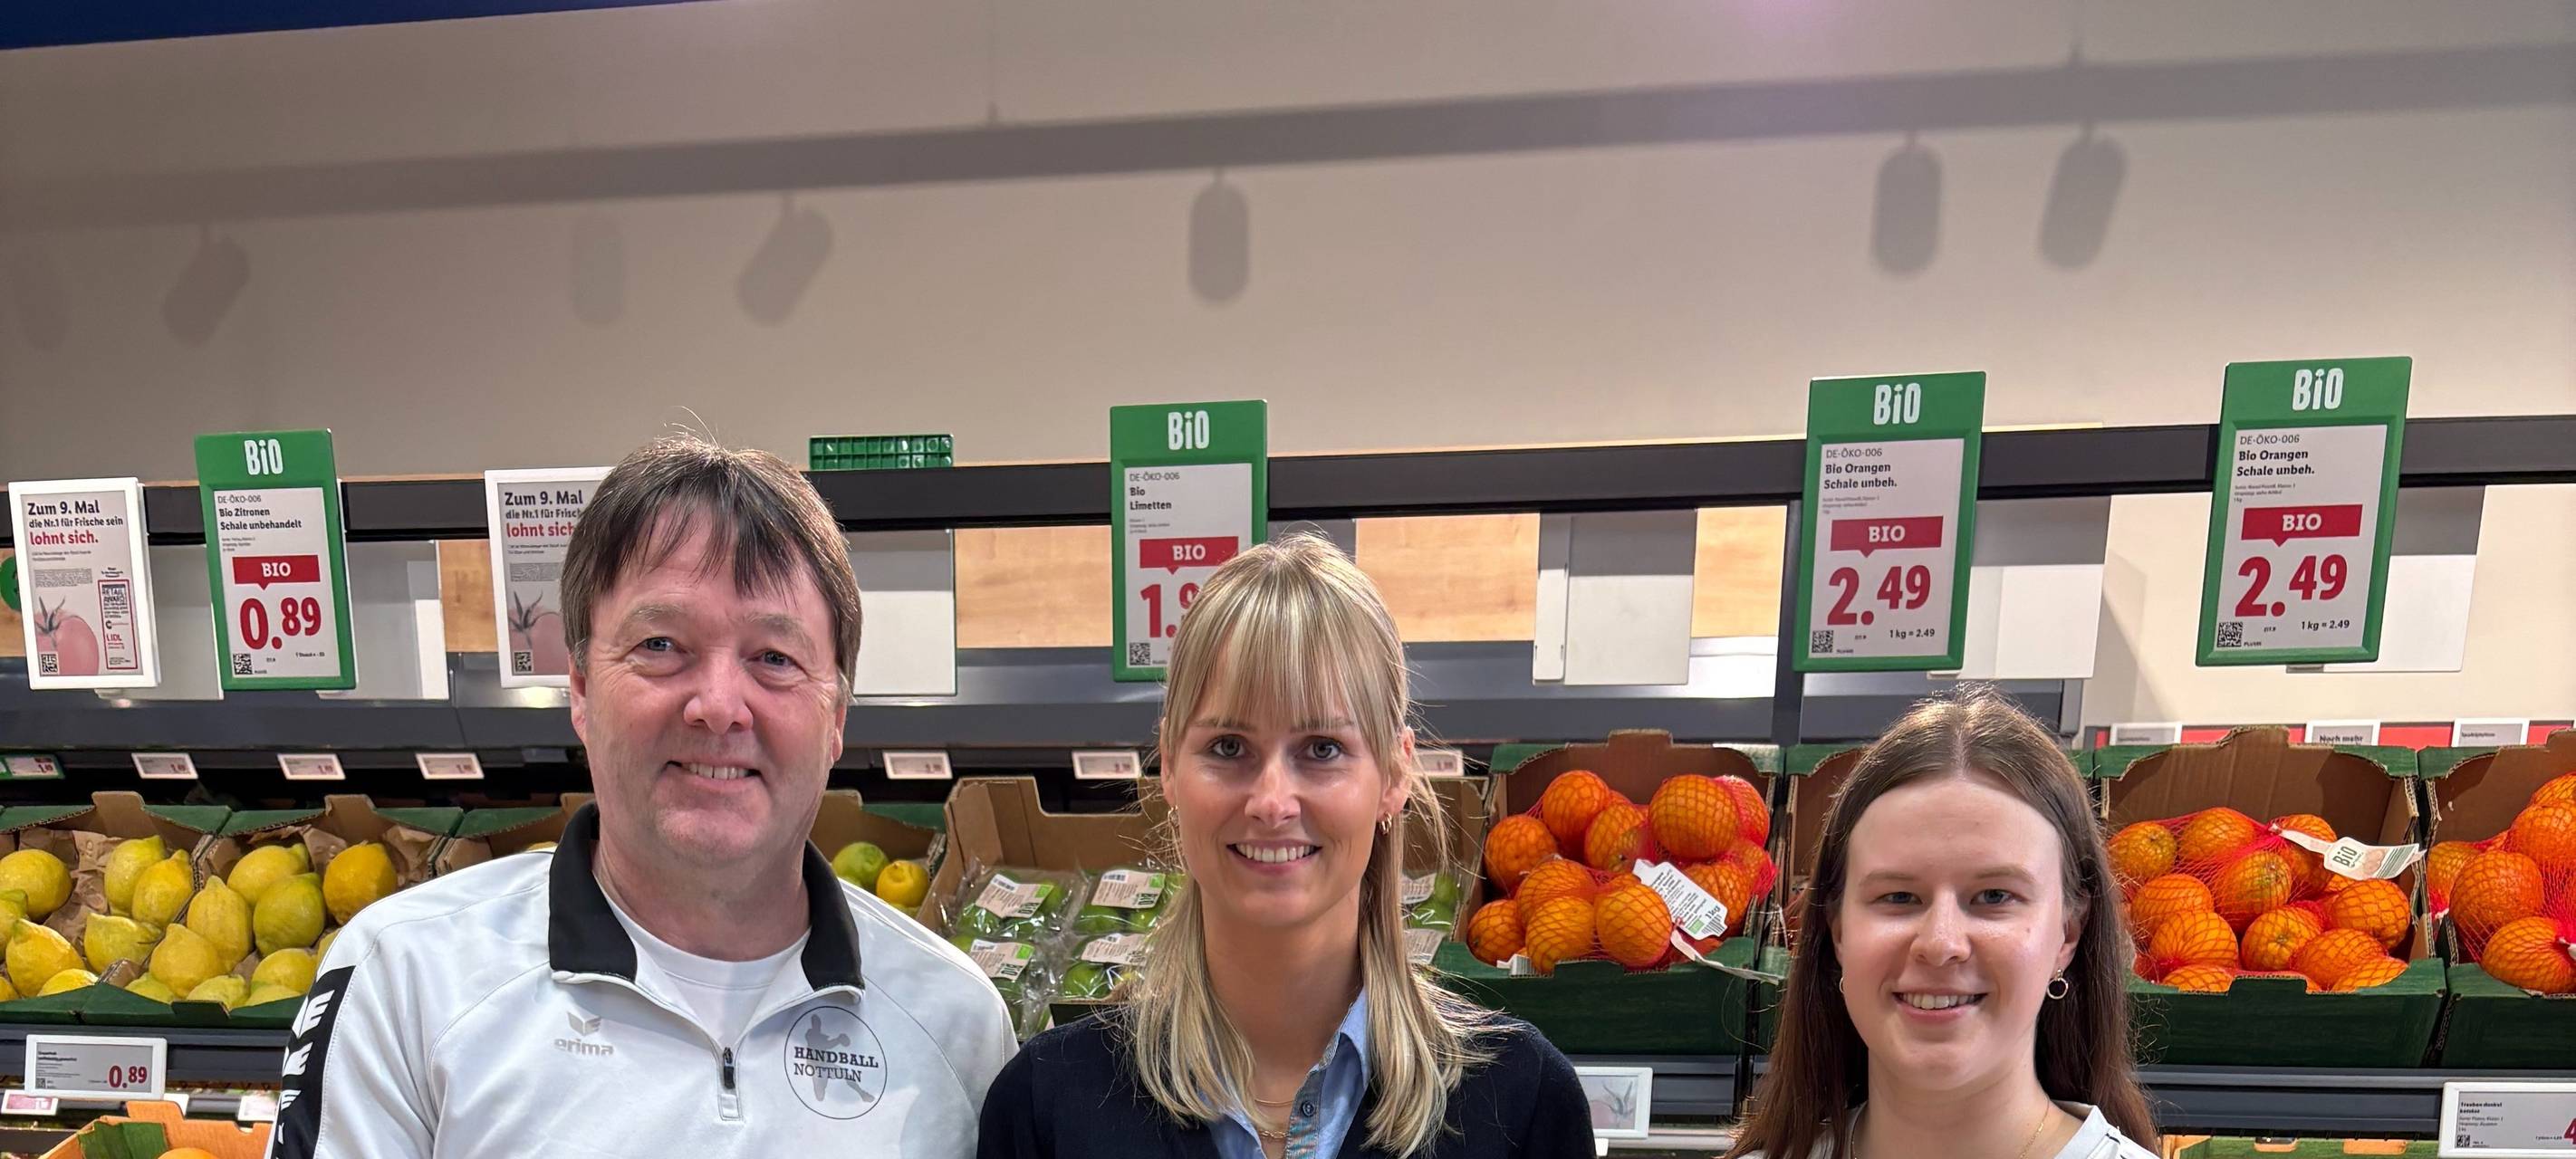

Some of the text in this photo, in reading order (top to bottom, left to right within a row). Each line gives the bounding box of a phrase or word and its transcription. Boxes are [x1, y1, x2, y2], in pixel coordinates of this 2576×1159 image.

[2292, 368, 2344, 411] BiO
[1873, 382, 1922, 426] BiO
[1168, 410, 1210, 451] BiO
[2240, 434, 2300, 445] DE-ÖKO-006
[244, 438, 284, 475] BiO
[1825, 447, 1882, 458] DE-ÖKO-006
[2239, 449, 2309, 462] Bio Orangen
[1129, 471, 1180, 482] DE-ÖKO-006
[1825, 463, 1891, 475] Bio Orangen
[2236, 464, 2315, 476] Schale unbeh.
[1129, 486, 1146, 496] Bio
[1823, 477, 1898, 489] Schale unbeh.
[217, 494, 262, 504] DE-ÖKO-006
[505, 489, 583, 506] Zum 9. Mal
[27, 499, 100, 516] Zum 9. Mal
[219, 507, 270, 517] Bio Zitronen
[505, 507, 582, 519] die Nr.1 für Frisc
[1129, 501, 1172, 511] Limetten
[29, 515, 123, 528] die Nr.1 für Frische sein
[220, 520, 302, 531] Schale unbehandelt
[506, 521, 574, 538] lohnt sich
[2282, 513, 2322, 532] BIO
[30, 529, 99, 545] lohnt sich.
[1869, 525, 1906, 542] BIO
[1172, 544, 1206, 560] BIO
[261, 562, 292, 578] BIO
[2235, 554, 2348, 618] 2.49
[1827, 565, 1931, 626] 2.49
[240, 597, 322, 650] 0.89
[2301, 621, 2305, 630] 1
[2307, 621, 2320, 631] kg
[2329, 619, 2350, 629] 2.49
[107, 634, 122, 642] LIDL
[1889, 629, 1894, 638] 1
[1896, 629, 1907, 639] kg
[1916, 628, 1936, 637] 2.49
[553, 1039, 614, 1056] erima
[793, 1046, 879, 1068] HANDBALL
[109, 1065, 148, 1088] 0.89
[793, 1063, 862, 1083] NOTTULN
